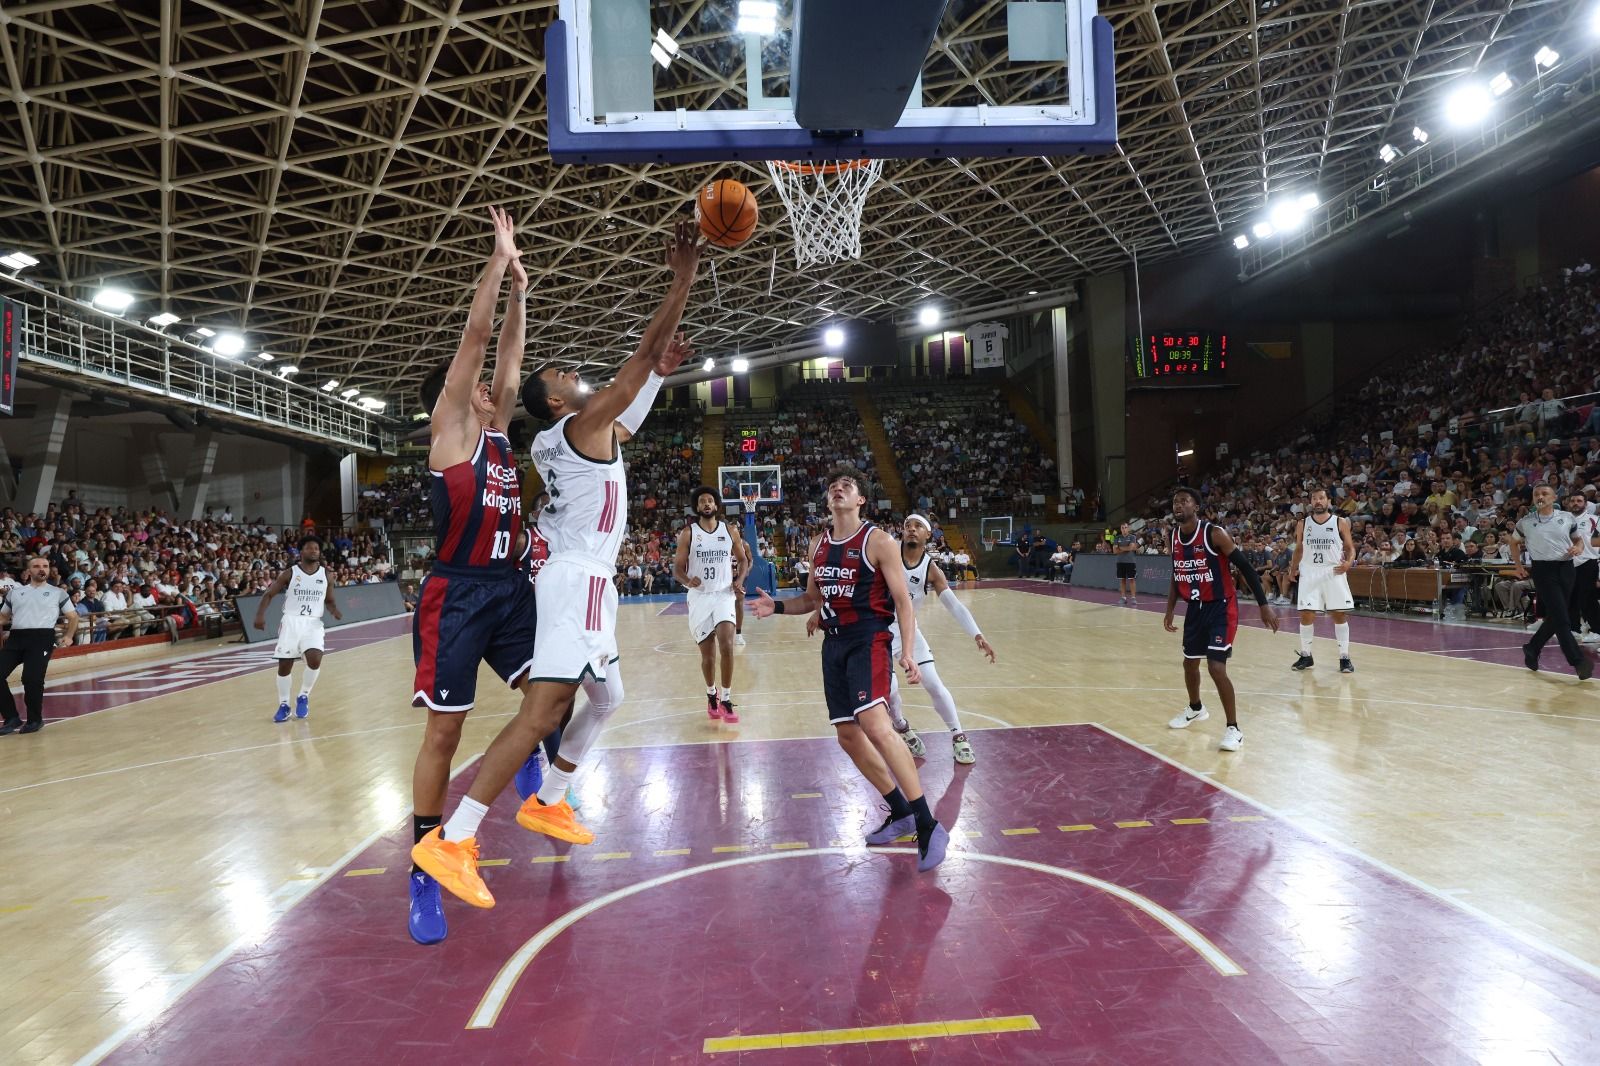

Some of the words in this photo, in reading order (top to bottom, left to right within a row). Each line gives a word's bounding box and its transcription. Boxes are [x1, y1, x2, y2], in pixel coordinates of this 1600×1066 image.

[1163, 337, 1174, 346] 50
[1188, 336, 1199, 346] 30
[1169, 350, 1192, 360] 08:39
[742, 439, 757, 452] 20
[490, 530, 511, 559] 10
[696, 549, 729, 558] Emirates
[1313, 552, 1324, 564] 23
[703, 566, 716, 580] 33
[1190, 588, 1200, 601] 2
[300, 604, 312, 616] 24
